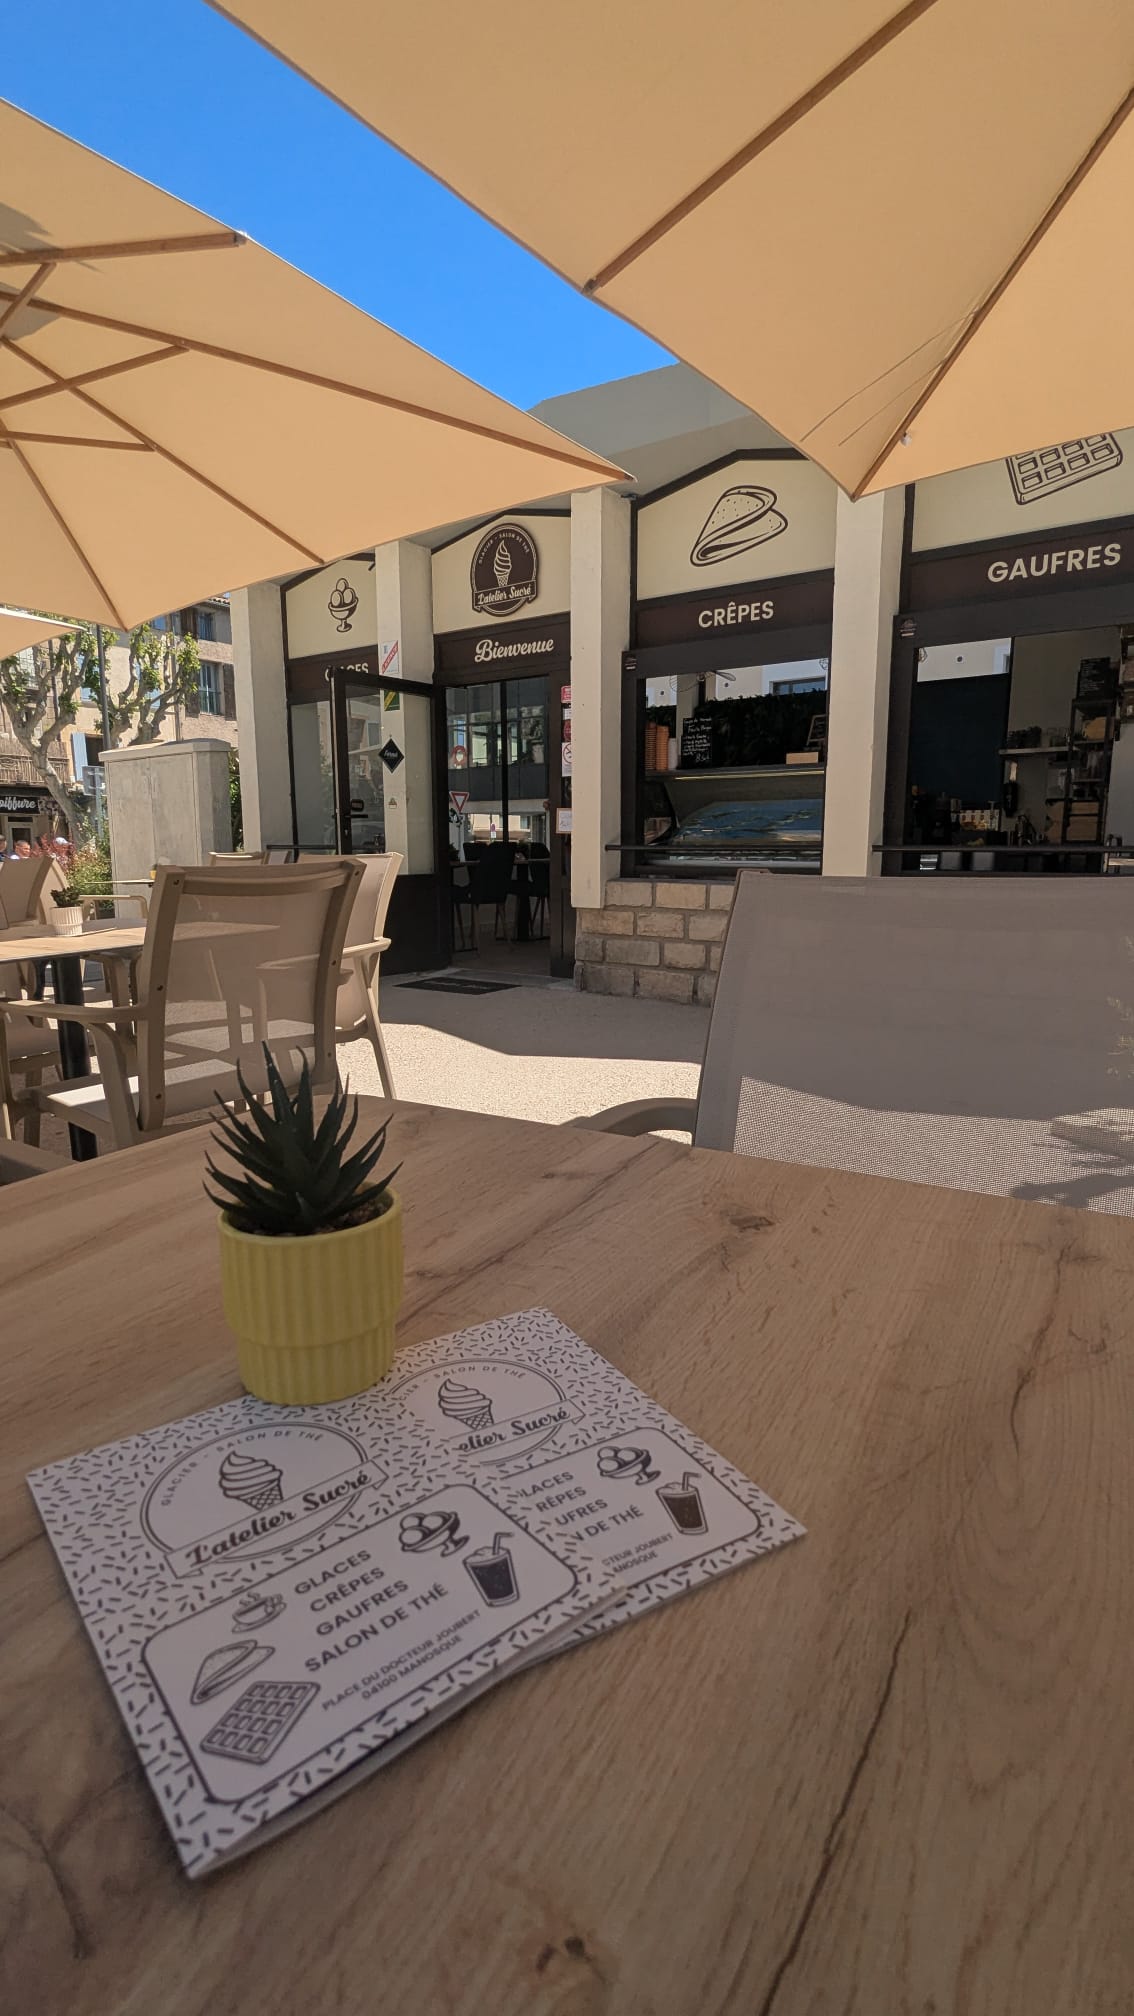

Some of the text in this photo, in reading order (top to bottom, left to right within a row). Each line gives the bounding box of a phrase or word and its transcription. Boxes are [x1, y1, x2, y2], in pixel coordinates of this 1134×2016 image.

[987, 542, 1122, 584] GAUFRES
[509, 585, 531, 598] Sucré
[698, 600, 775, 629] CRÊPES
[474, 638, 555, 663] Bienvenue
[510, 1406, 571, 1436] Sucré
[161, 1461, 198, 1507] GLACIER
[217, 1433, 266, 1452] SALON
[273, 1430, 291, 1438] DE
[298, 1430, 324, 1442] THÉ
[517, 1472, 574, 1498] LACES
[185, 1470, 373, 1568] L'atelier Sucré
[535, 1486, 587, 1512] RÊPES
[555, 1499, 608, 1526] UFRES
[584, 1519, 610, 1537] DE
[608, 1504, 644, 1526] THÉ
[294, 1550, 371, 1595] GLACES
[309, 1567, 385, 1612] CRÊPES
[304, 1582, 449, 1673] SALON DE THÉ
[315, 1580, 409, 1636] GAUFRES
[321, 1609, 481, 1712] PLACE DU DOCTEUR JOUBERT
[361, 1634, 463, 1701] 04100 MANOSQUE
